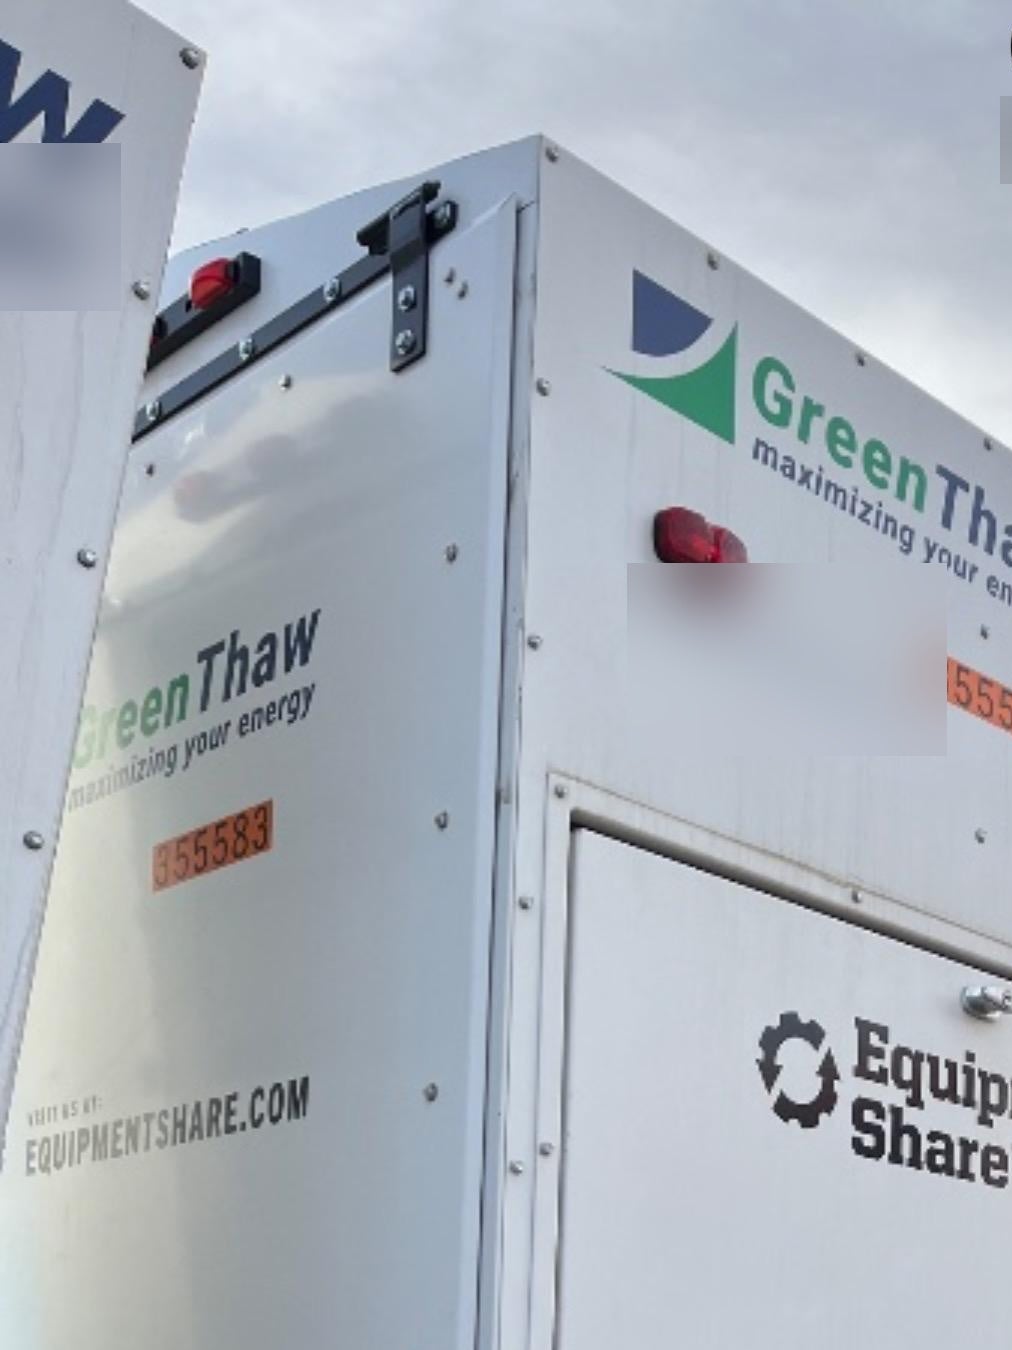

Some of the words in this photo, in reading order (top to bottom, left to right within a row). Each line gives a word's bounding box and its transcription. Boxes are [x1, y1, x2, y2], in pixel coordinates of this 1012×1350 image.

[752, 437, 916, 555] maximizing
[923, 537, 979, 583] your
[67, 744, 178, 812] maximizing
[182, 719, 231, 771] your
[238, 683, 316, 738] energy
[155, 805, 268, 885] 355583
[26, 1076, 310, 1176] EQUIPMENTSHARE.COM
